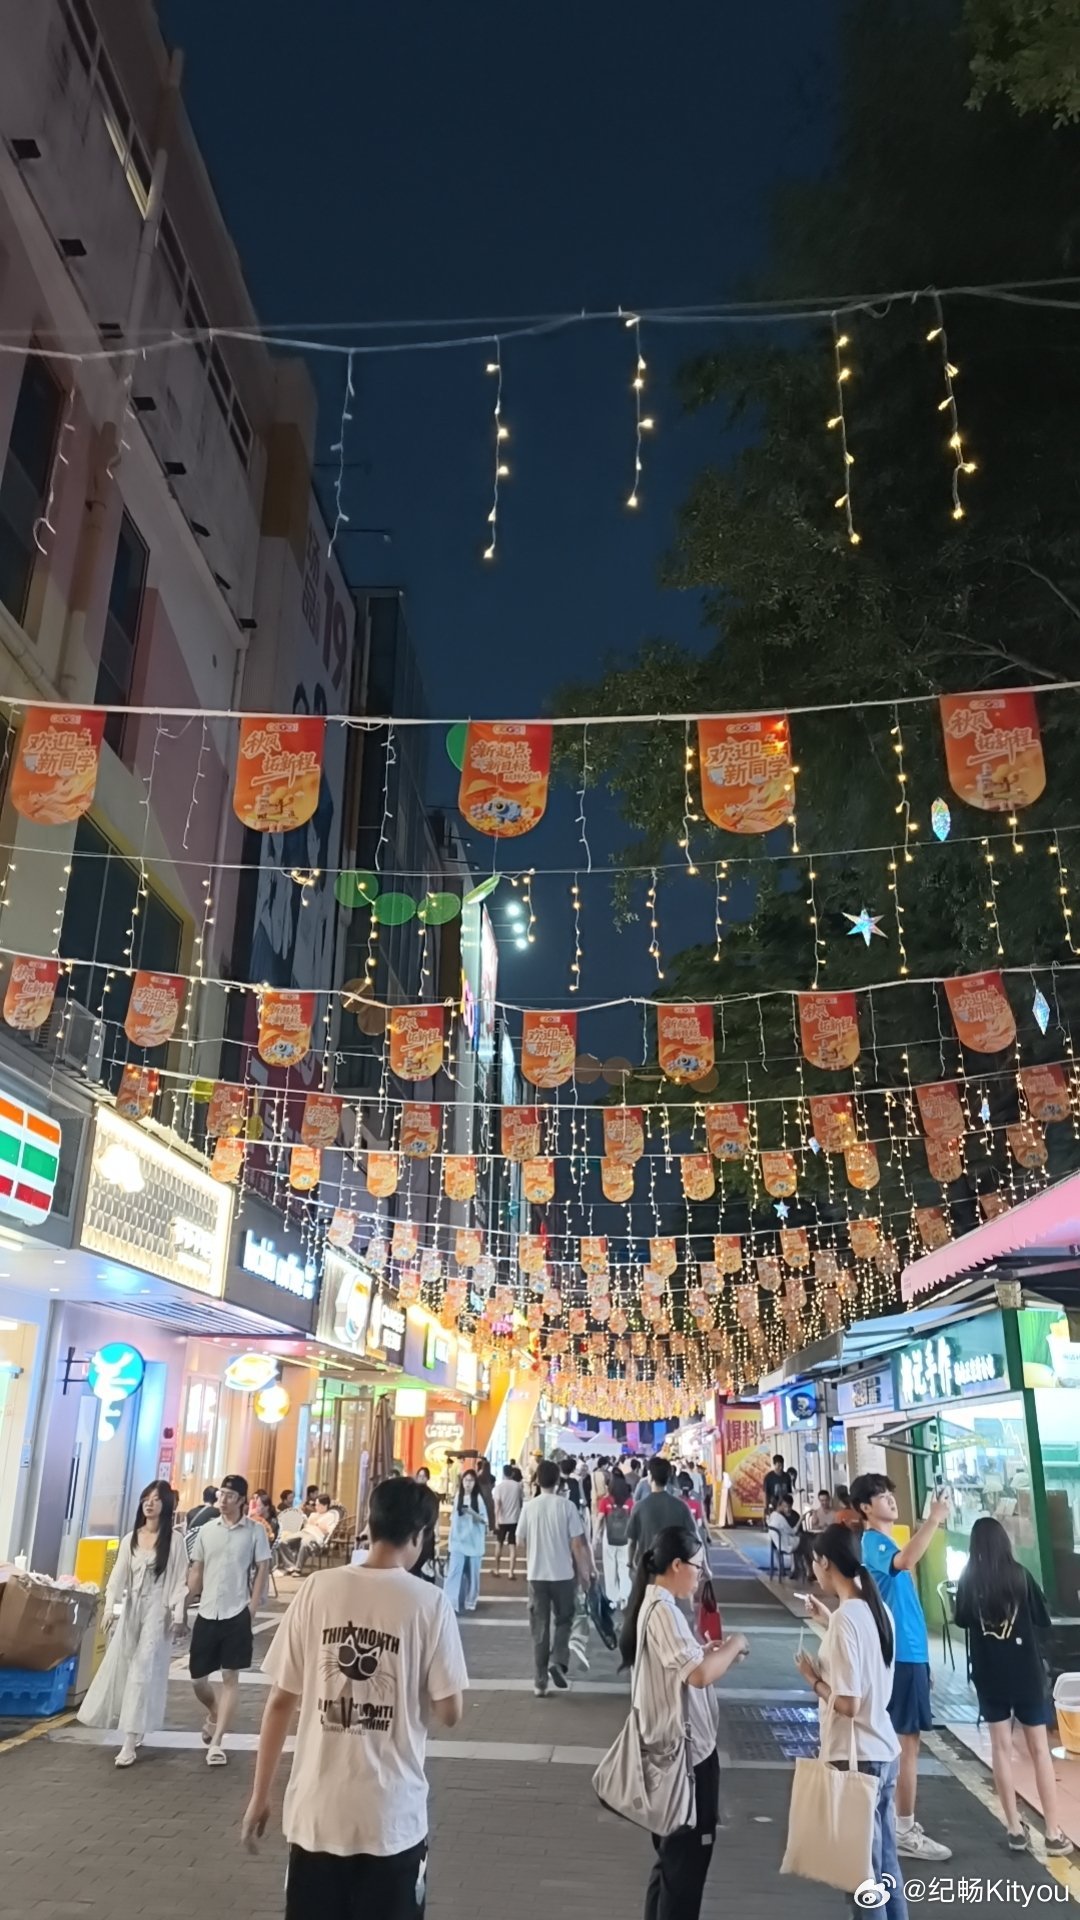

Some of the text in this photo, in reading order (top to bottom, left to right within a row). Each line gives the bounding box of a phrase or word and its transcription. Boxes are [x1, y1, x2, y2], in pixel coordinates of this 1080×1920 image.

[24, 731, 77, 753] 欢迎
[704, 740, 761, 765] 欢迎
[36, 750, 96, 776] 新同学
[724, 756, 789, 786] 新同学
